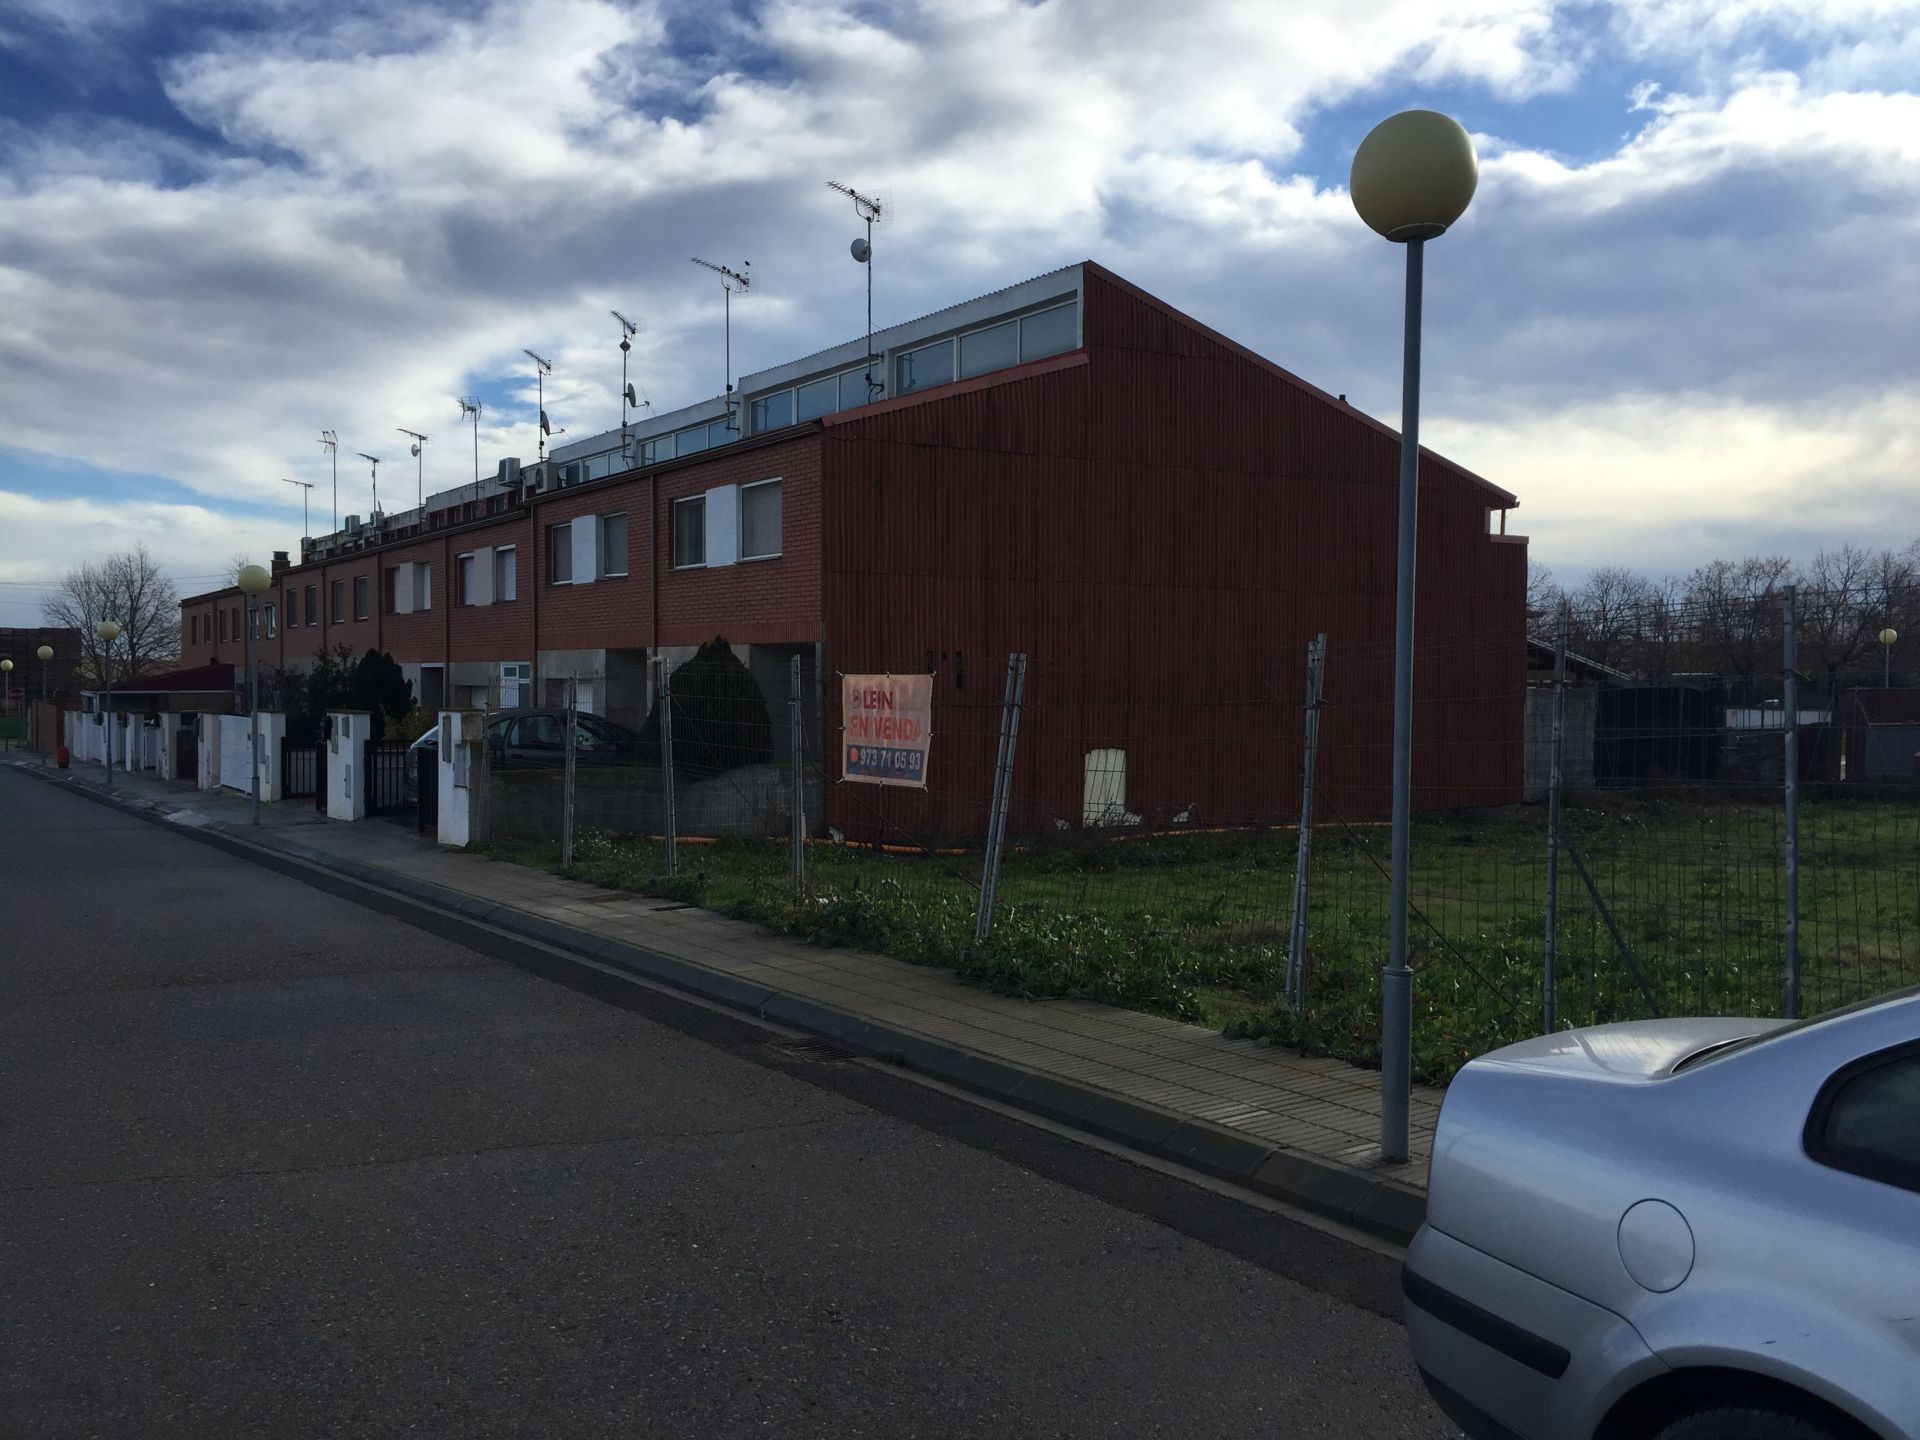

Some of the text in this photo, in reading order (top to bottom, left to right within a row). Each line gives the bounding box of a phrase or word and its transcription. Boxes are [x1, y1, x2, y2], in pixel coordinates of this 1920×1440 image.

[849, 715, 922, 741] EN VENDA
[860, 748, 921, 770] 973 71 05 93
